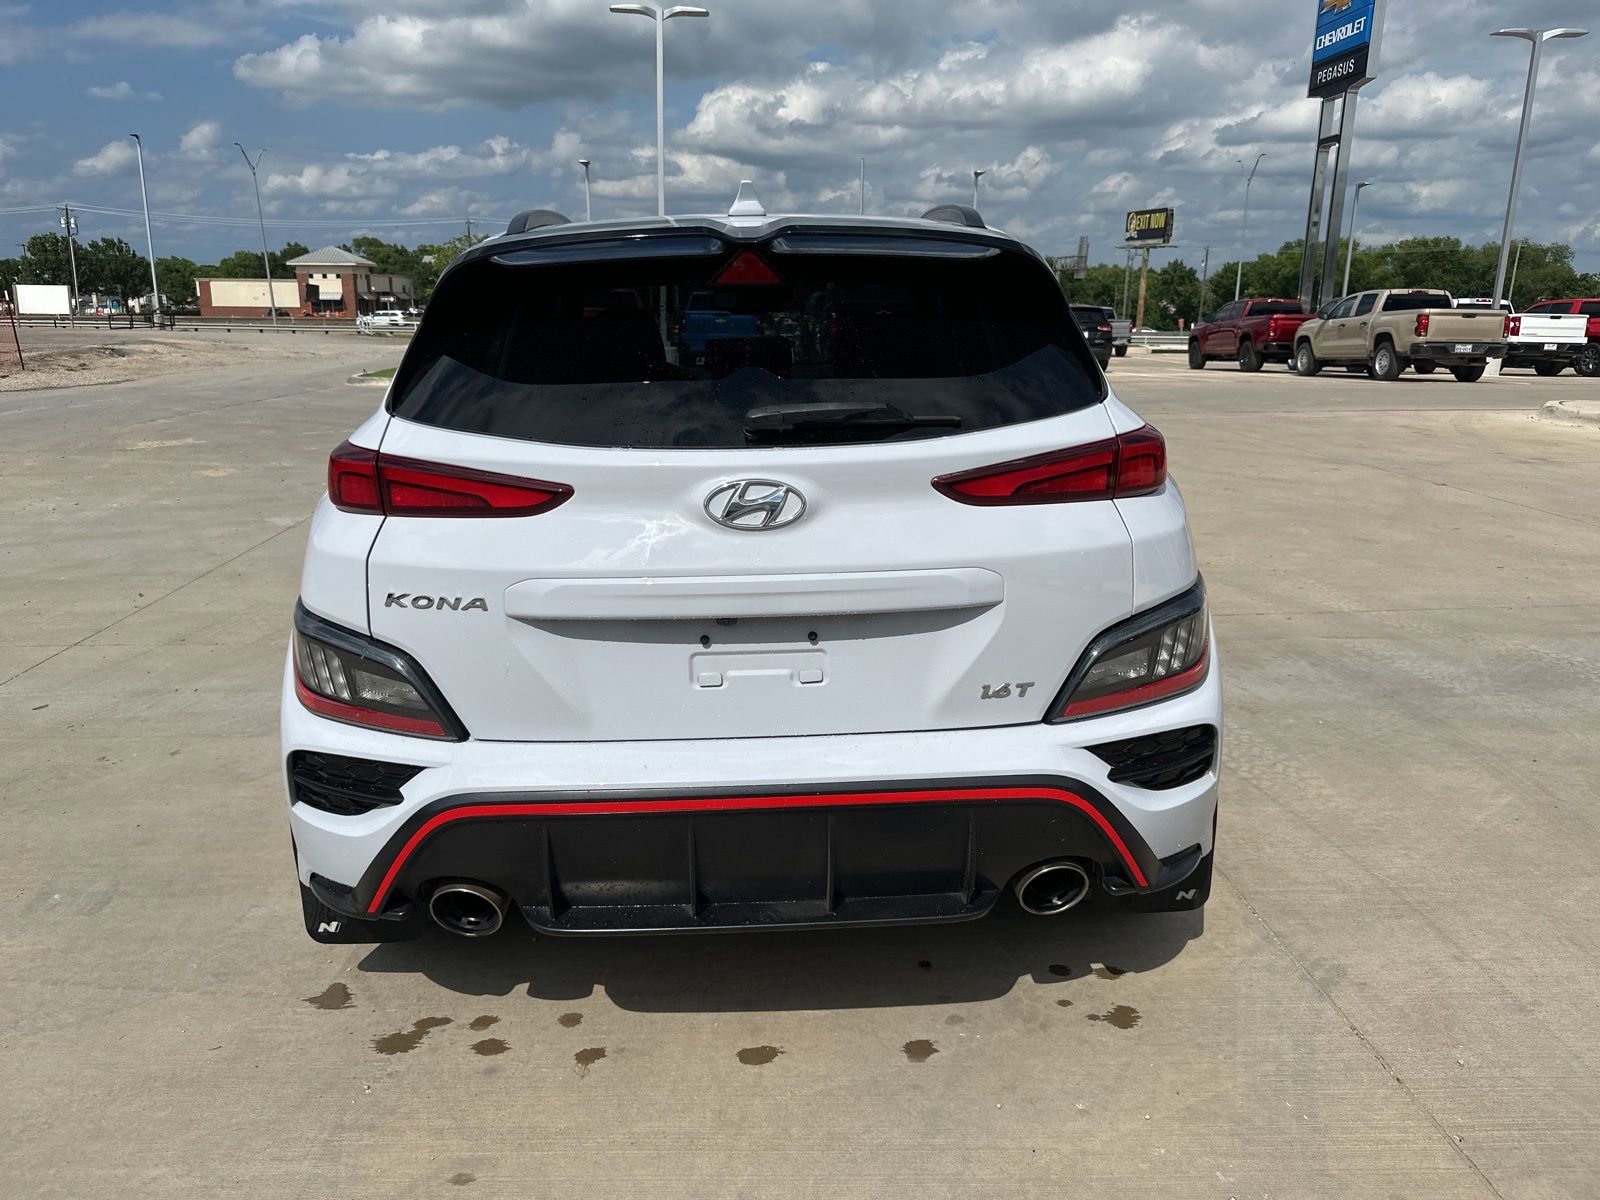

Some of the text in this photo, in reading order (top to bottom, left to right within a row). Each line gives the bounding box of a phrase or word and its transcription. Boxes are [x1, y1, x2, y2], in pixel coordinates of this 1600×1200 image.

[1316, 16, 1367, 50] CHEVROLET
[1317, 59, 1355, 84] PEGASUS
[1135, 214, 1150, 230] EXIT
[384, 593, 489, 612] KONA
